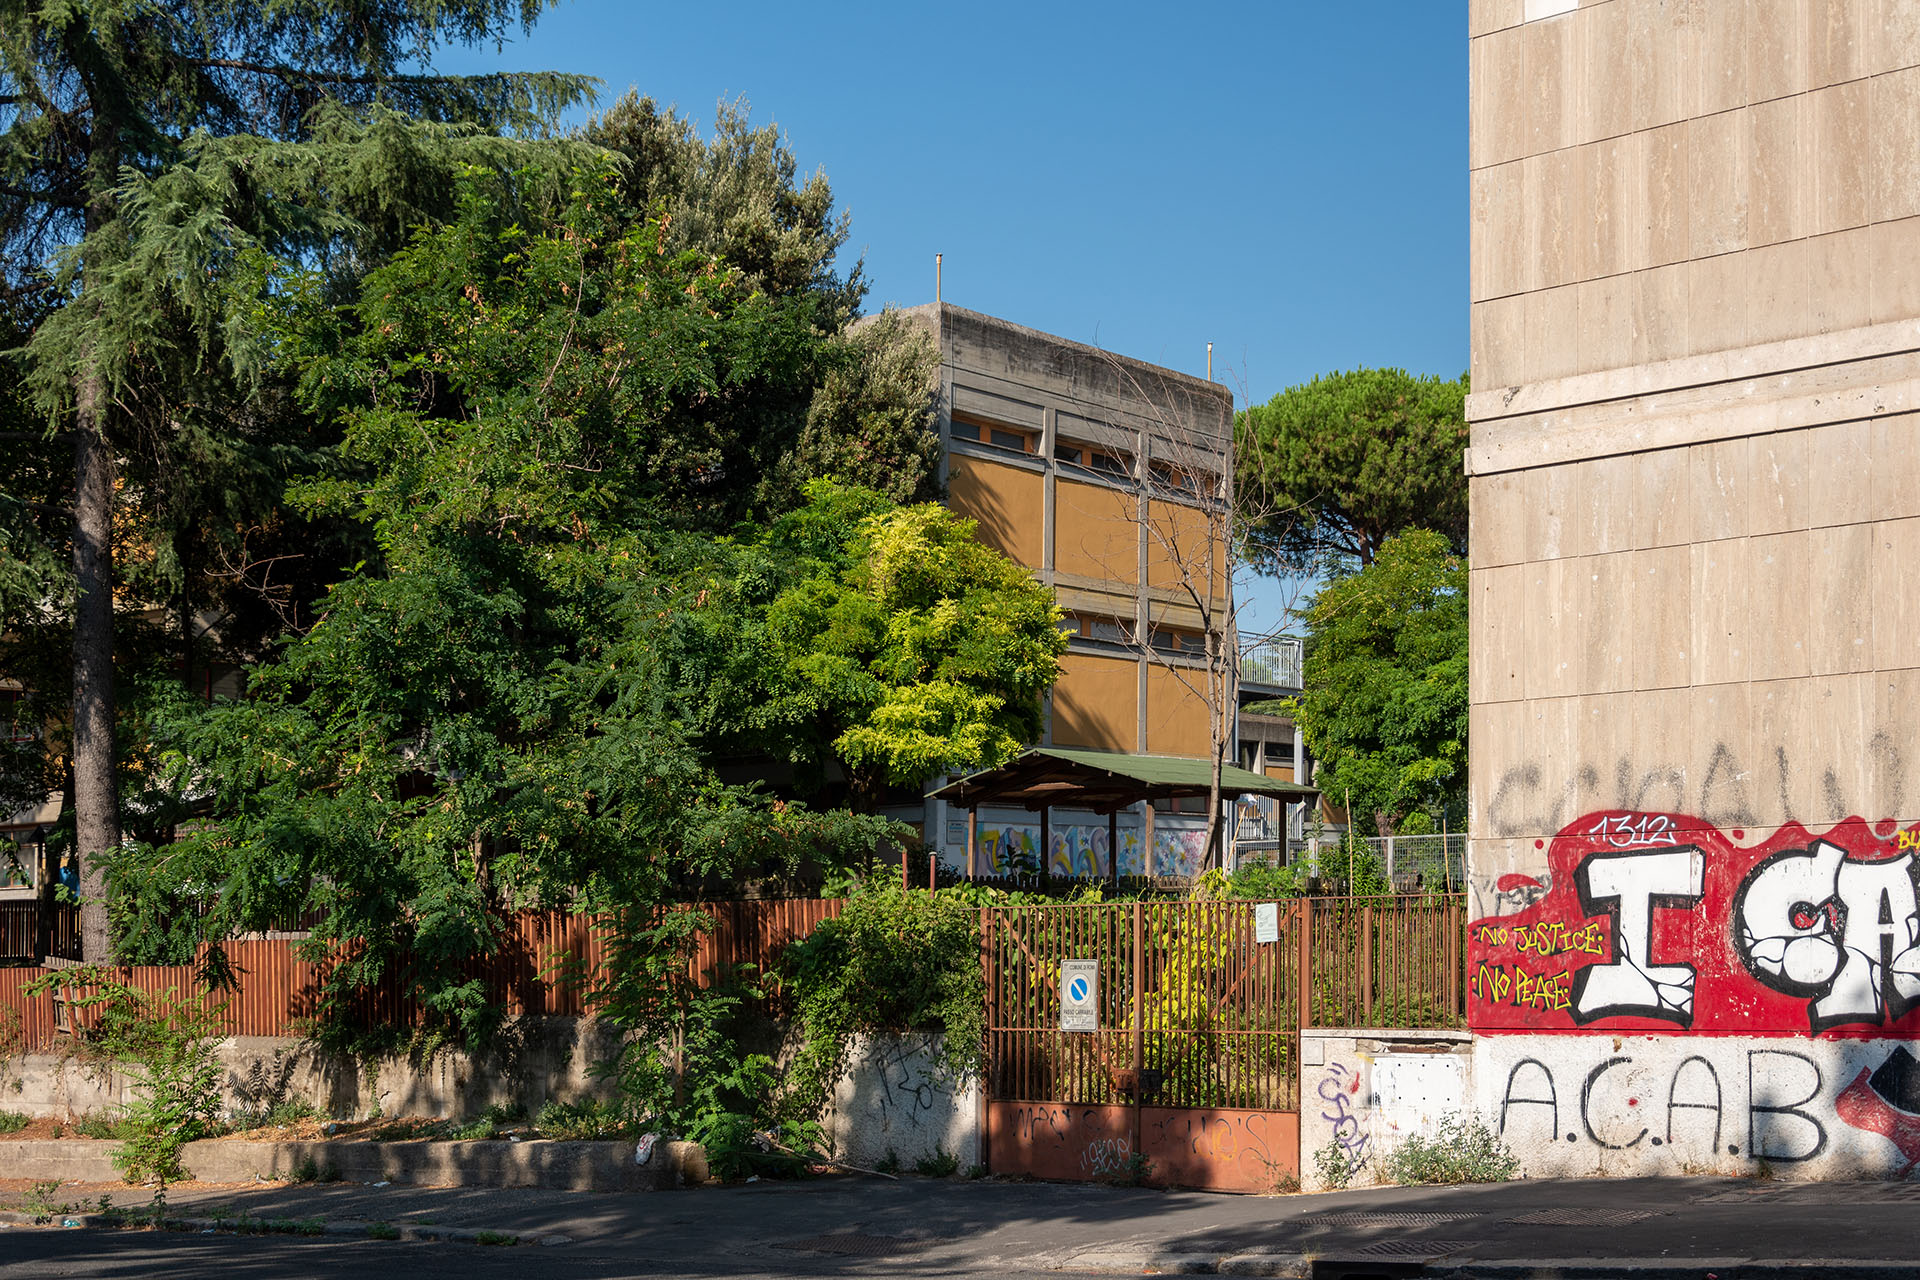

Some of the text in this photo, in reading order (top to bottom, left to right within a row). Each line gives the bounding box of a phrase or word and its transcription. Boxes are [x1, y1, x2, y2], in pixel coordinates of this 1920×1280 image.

[1478, 921, 1605, 955] NO JUSTICE
[1477, 963, 1573, 1011] NO PEACE
